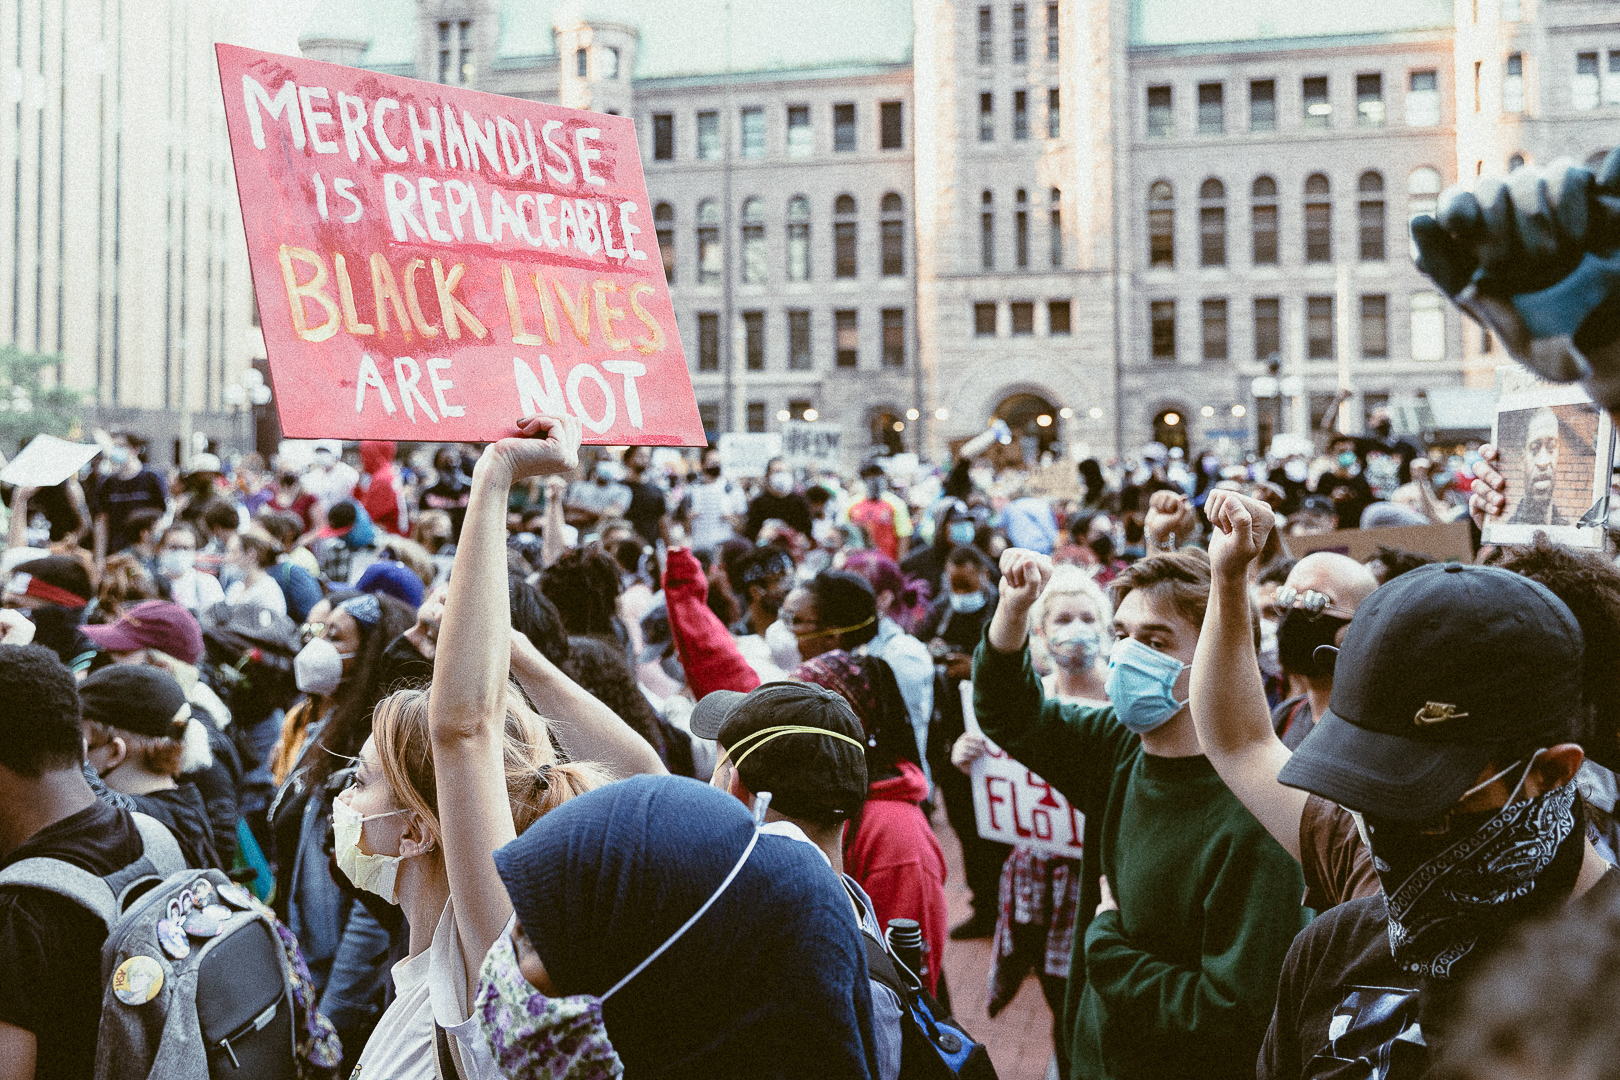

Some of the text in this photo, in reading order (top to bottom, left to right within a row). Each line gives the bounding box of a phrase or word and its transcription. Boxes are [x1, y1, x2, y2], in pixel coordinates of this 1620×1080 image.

[241, 74, 606, 187] MERCHANDISE
[314, 172, 648, 261] IS REPLACEABLE
[278, 242, 666, 354] BLACK LIVES
[355, 351, 647, 434] ARE NOT
